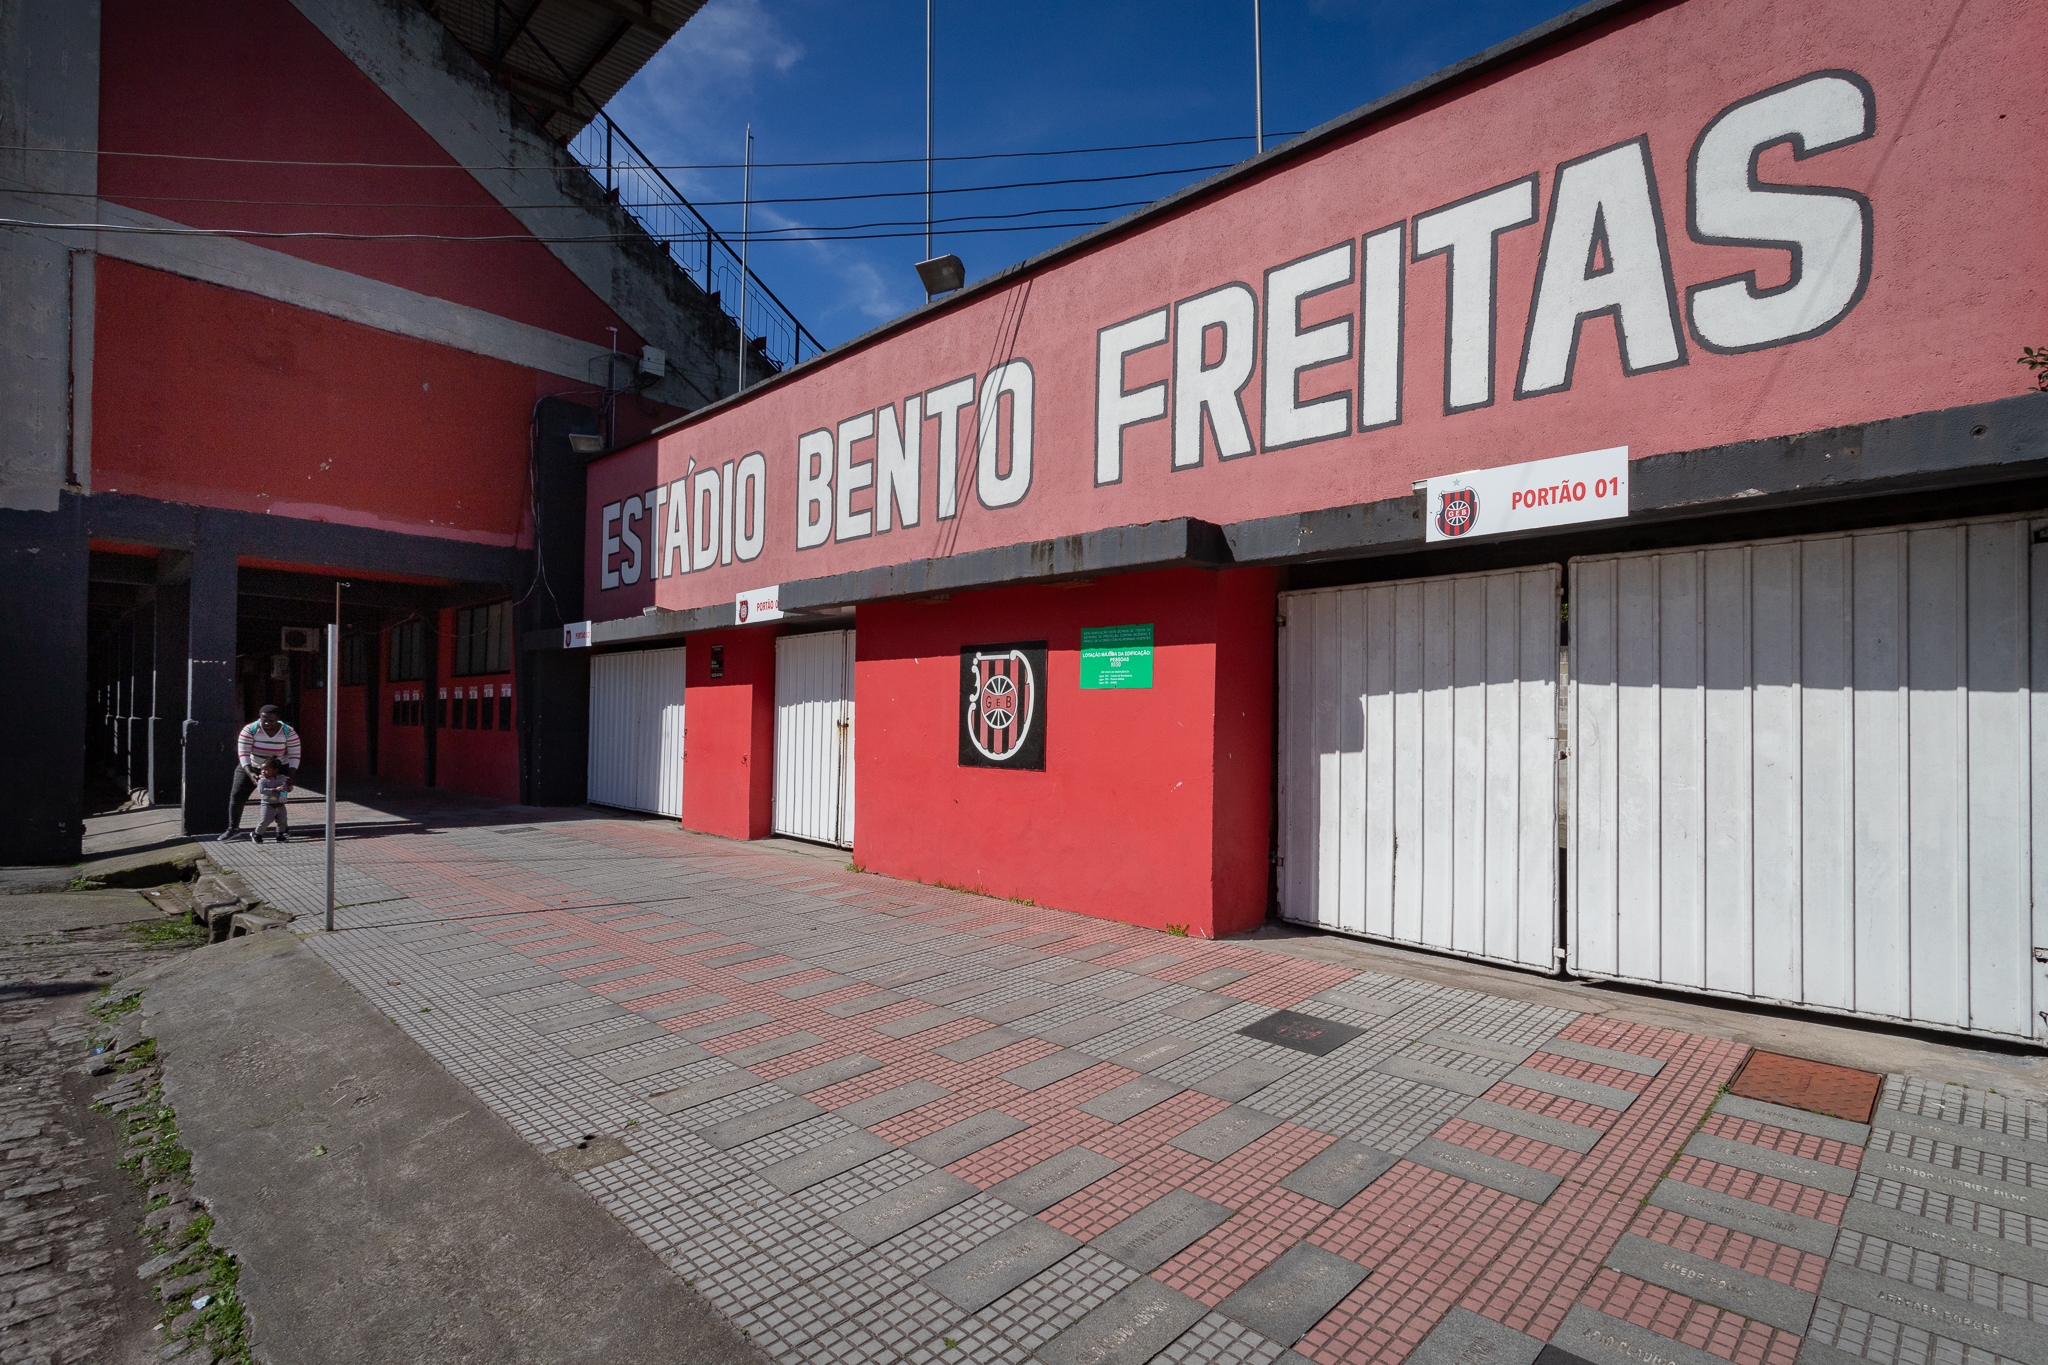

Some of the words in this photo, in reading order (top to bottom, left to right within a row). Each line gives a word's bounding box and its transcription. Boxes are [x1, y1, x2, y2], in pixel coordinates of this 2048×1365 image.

[600, 455, 766, 592] ESTÁDIO
[795, 357, 1035, 552] BENTO
[1094, 68, 1876, 488] FREITAS
[1512, 479, 1586, 510] PORTÃO
[1595, 476, 1618, 498] 01
[757, 599, 774, 612] PORTÃO
